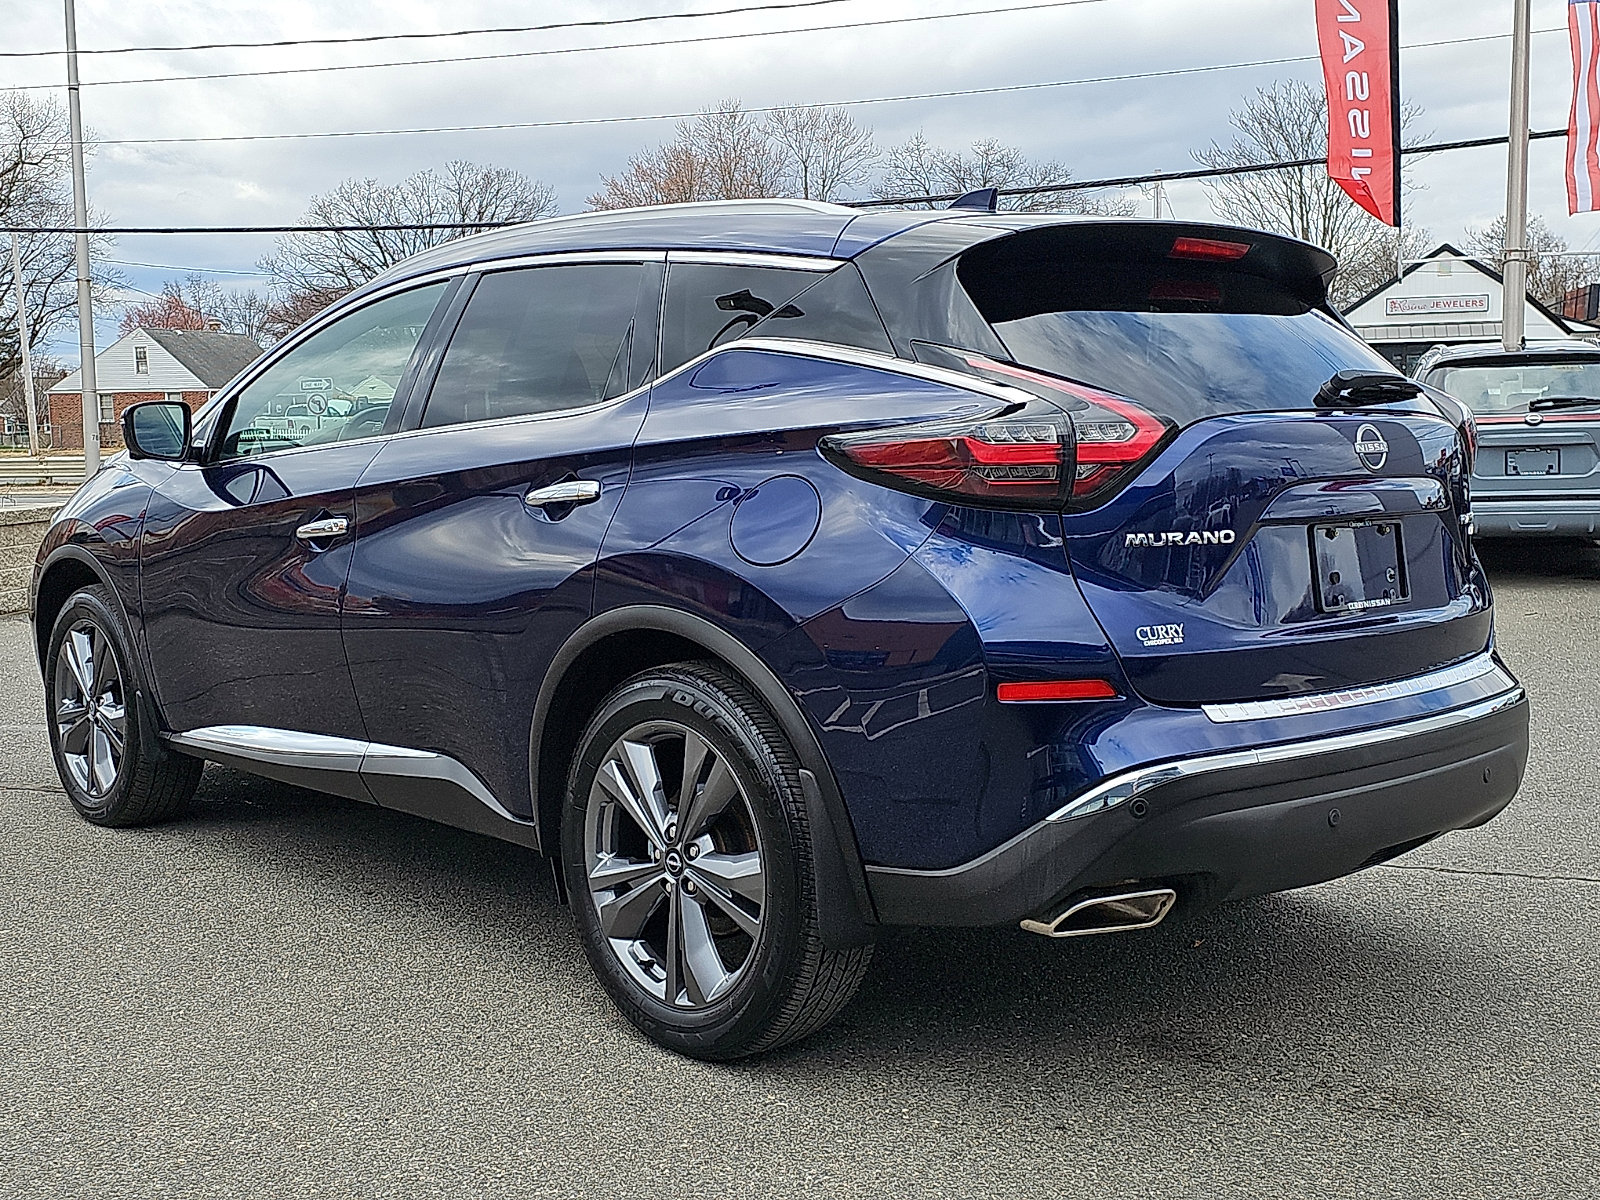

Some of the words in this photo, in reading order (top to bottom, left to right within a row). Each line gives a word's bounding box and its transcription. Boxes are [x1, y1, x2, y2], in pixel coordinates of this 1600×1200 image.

[1431, 300, 1484, 308] JEWELERS
[1124, 529, 1236, 548] MURANO
[1136, 622, 1185, 641] CURRY
